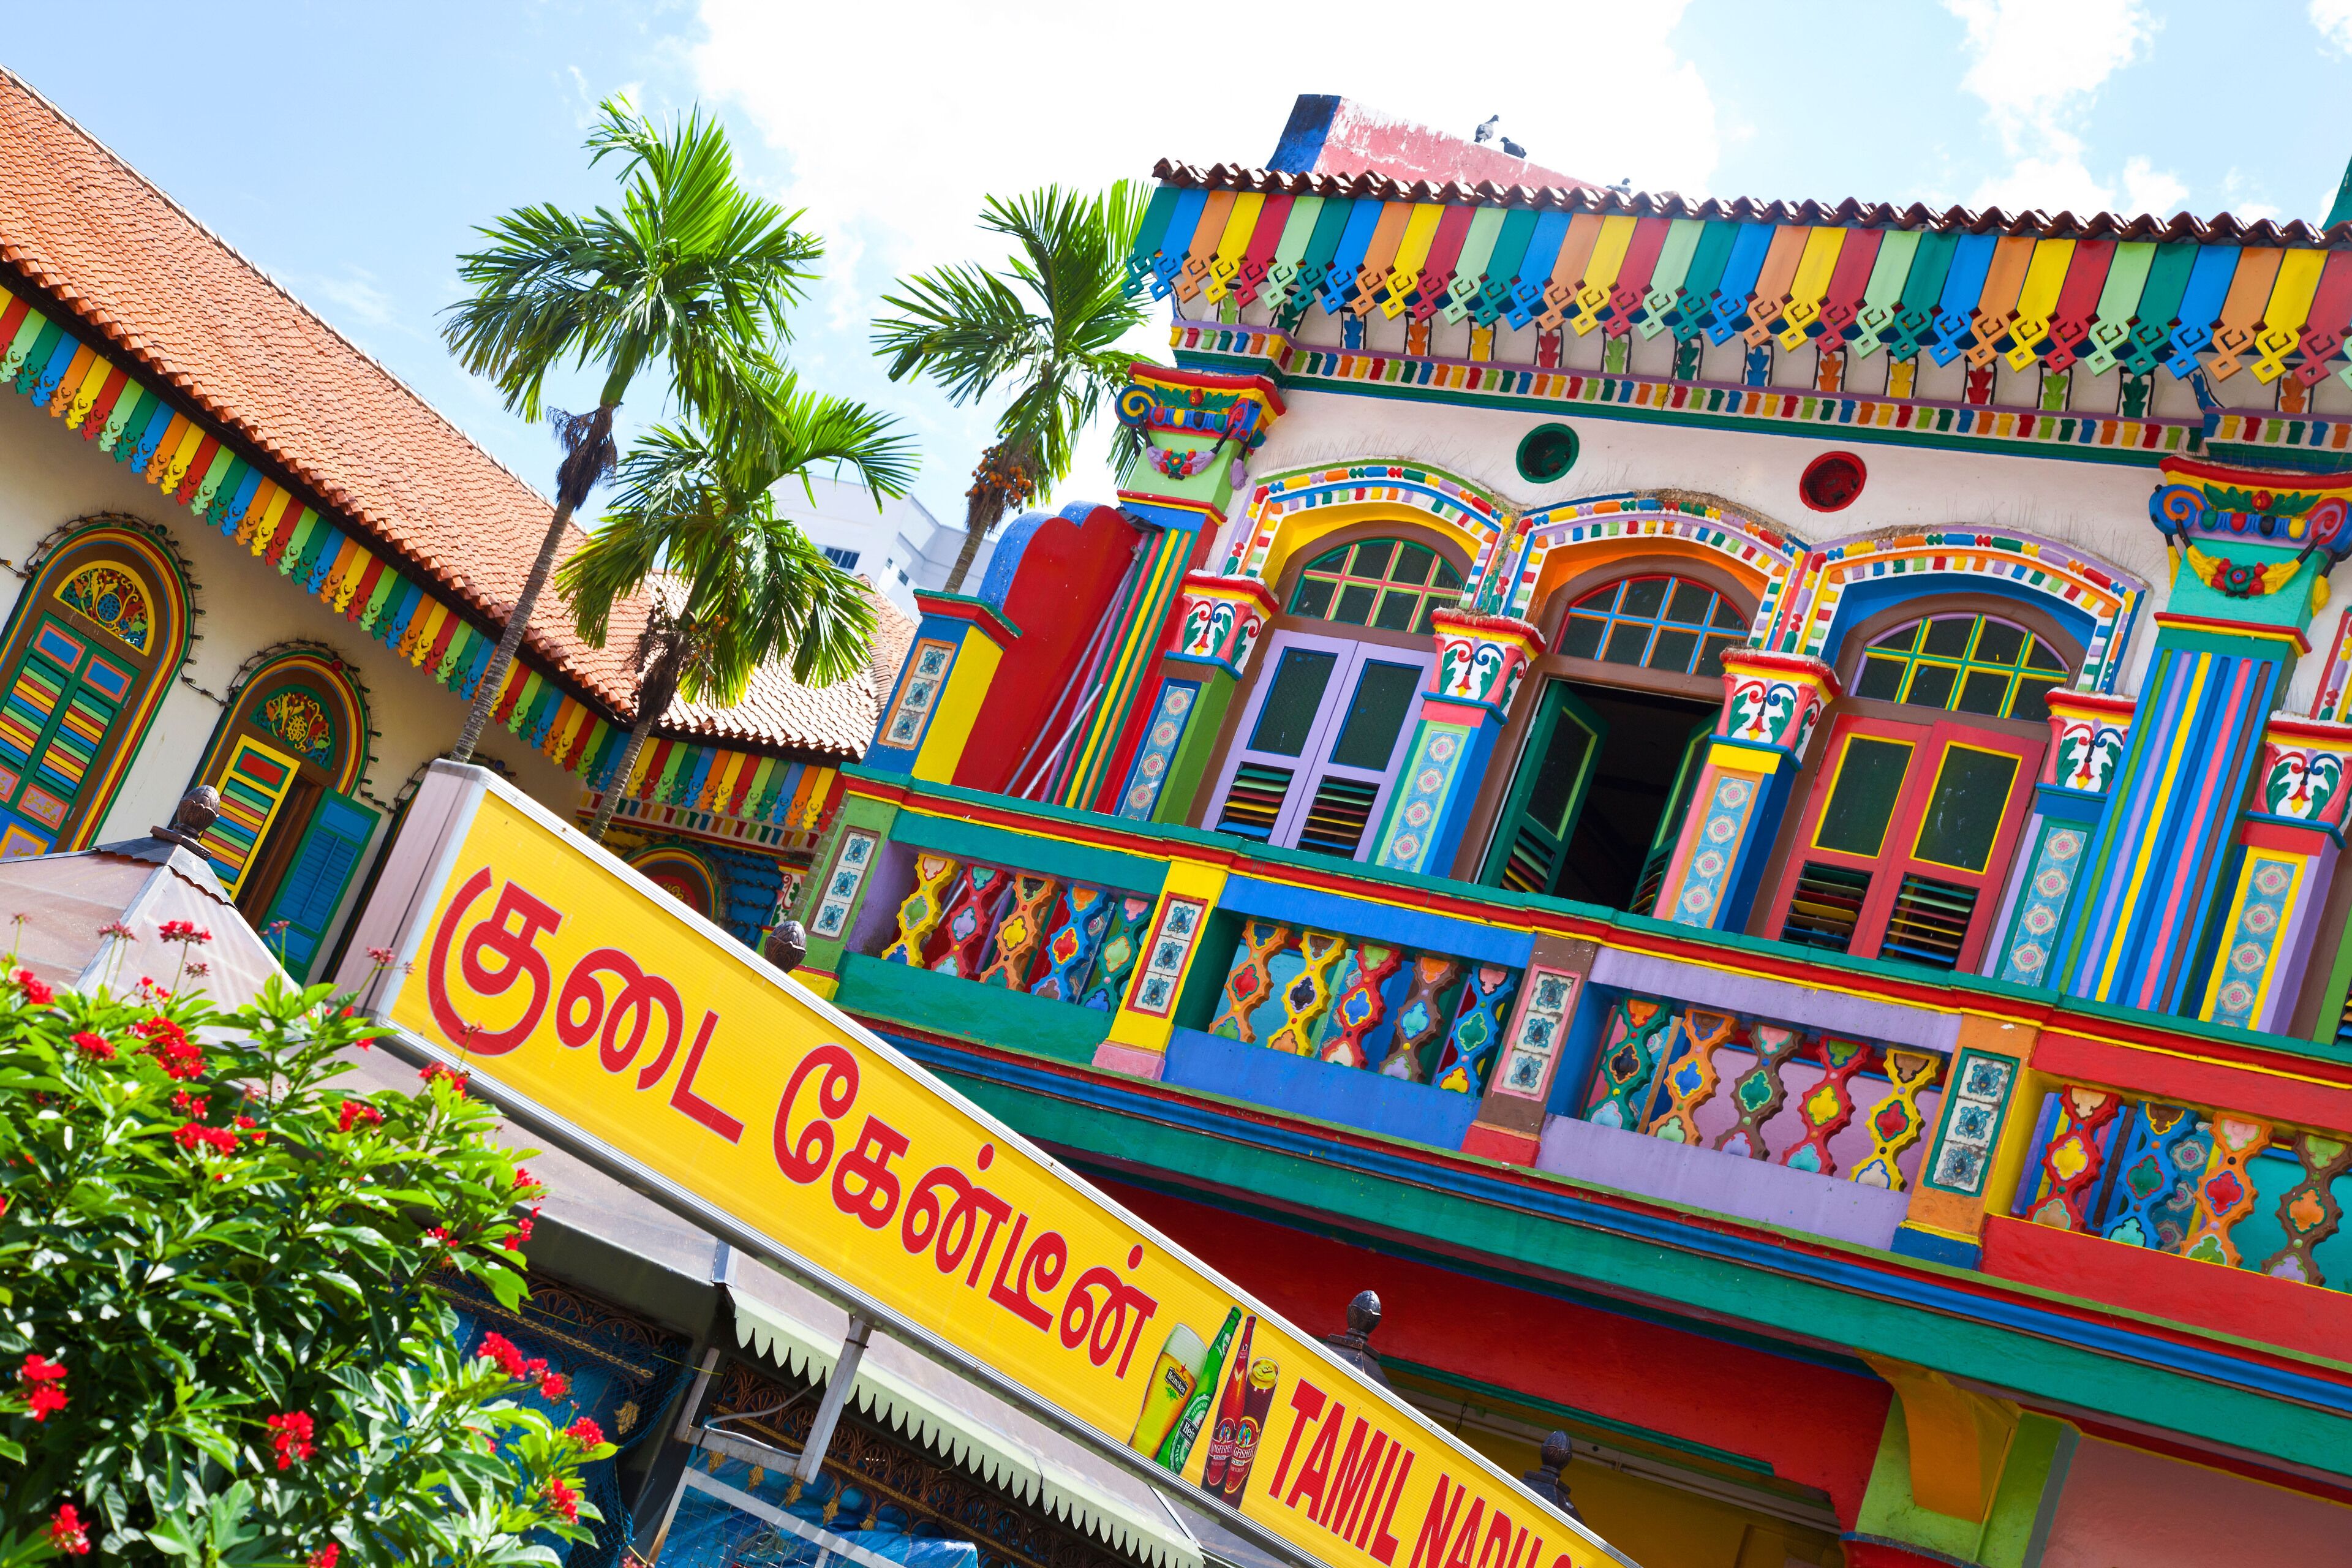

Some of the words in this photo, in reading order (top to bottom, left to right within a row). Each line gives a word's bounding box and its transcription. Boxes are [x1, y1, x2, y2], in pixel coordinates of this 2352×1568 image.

[428, 865, 745, 1145] குடை
[773, 1044, 1159, 1380] கேன்டீன்
[1167, 1371, 1186, 1394] Heineken
[1268, 1378, 1416, 1567] TAMIL
